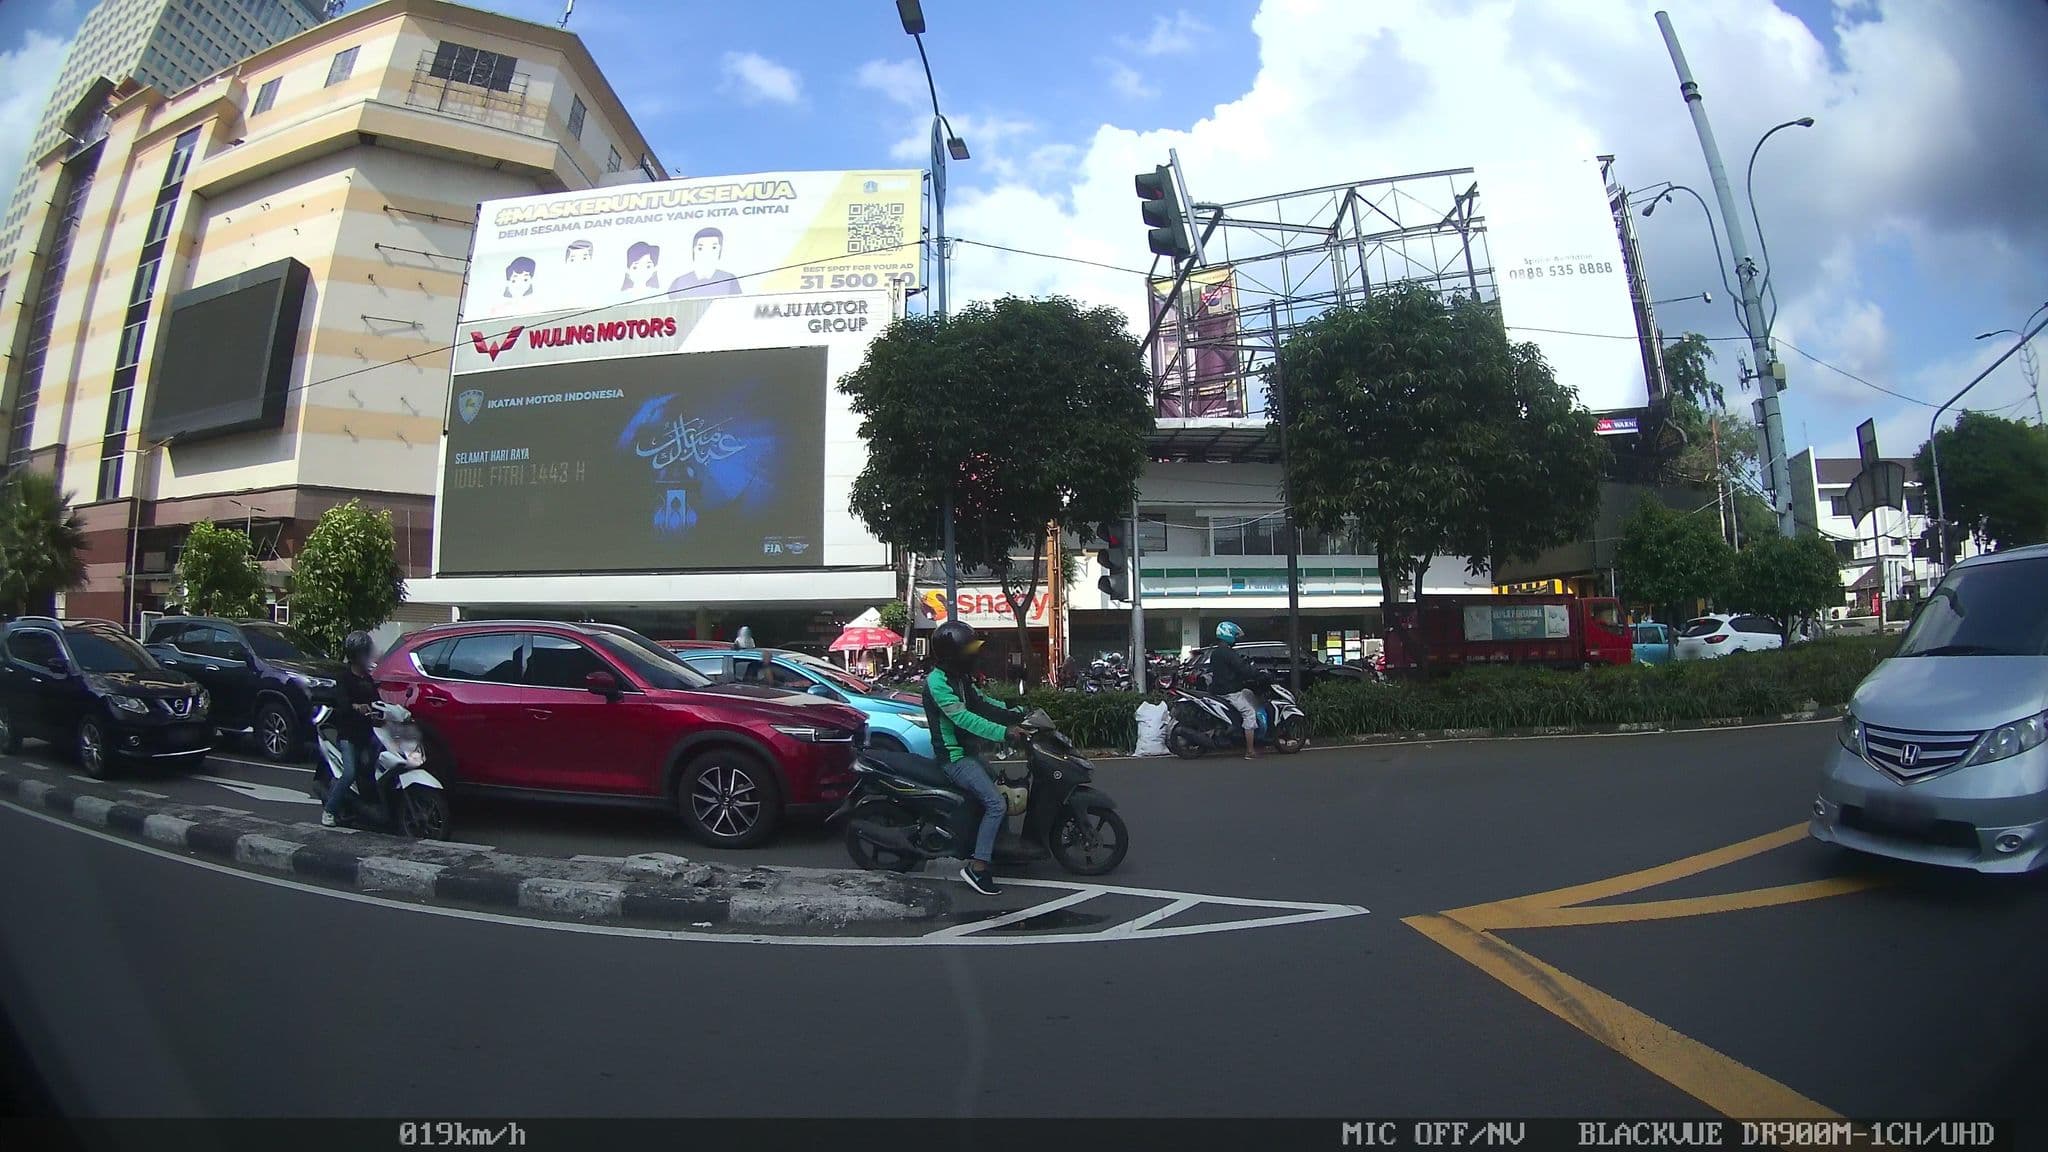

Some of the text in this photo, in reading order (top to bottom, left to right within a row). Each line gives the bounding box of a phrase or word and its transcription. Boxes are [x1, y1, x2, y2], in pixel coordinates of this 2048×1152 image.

[495, 181, 797, 227] #MASKERUNTUKSEMUA
[498, 205, 789, 239] DEMI SESAMA DAN ORANG YANG KITA CINTAI
[1549, 264, 1574, 277] 535
[800, 274, 824, 289] 31
[830, 273, 878, 288] 500
[753, 300, 868, 319] MAJU MOTOR
[529, 317, 677, 349] WULING MOTORS
[808, 316, 868, 333] GROUP
[488, 389, 624, 409] IKATAN MOTOR INDONESIA
[455, 447, 529, 465] SELAMAT HARI RAYA
[490, 463, 523, 486] FITRI
[529, 461, 568, 485] 1443
[576, 460, 585, 482] H
[763, 543, 783, 554] FIA
[957, 592, 1048, 620] snay
